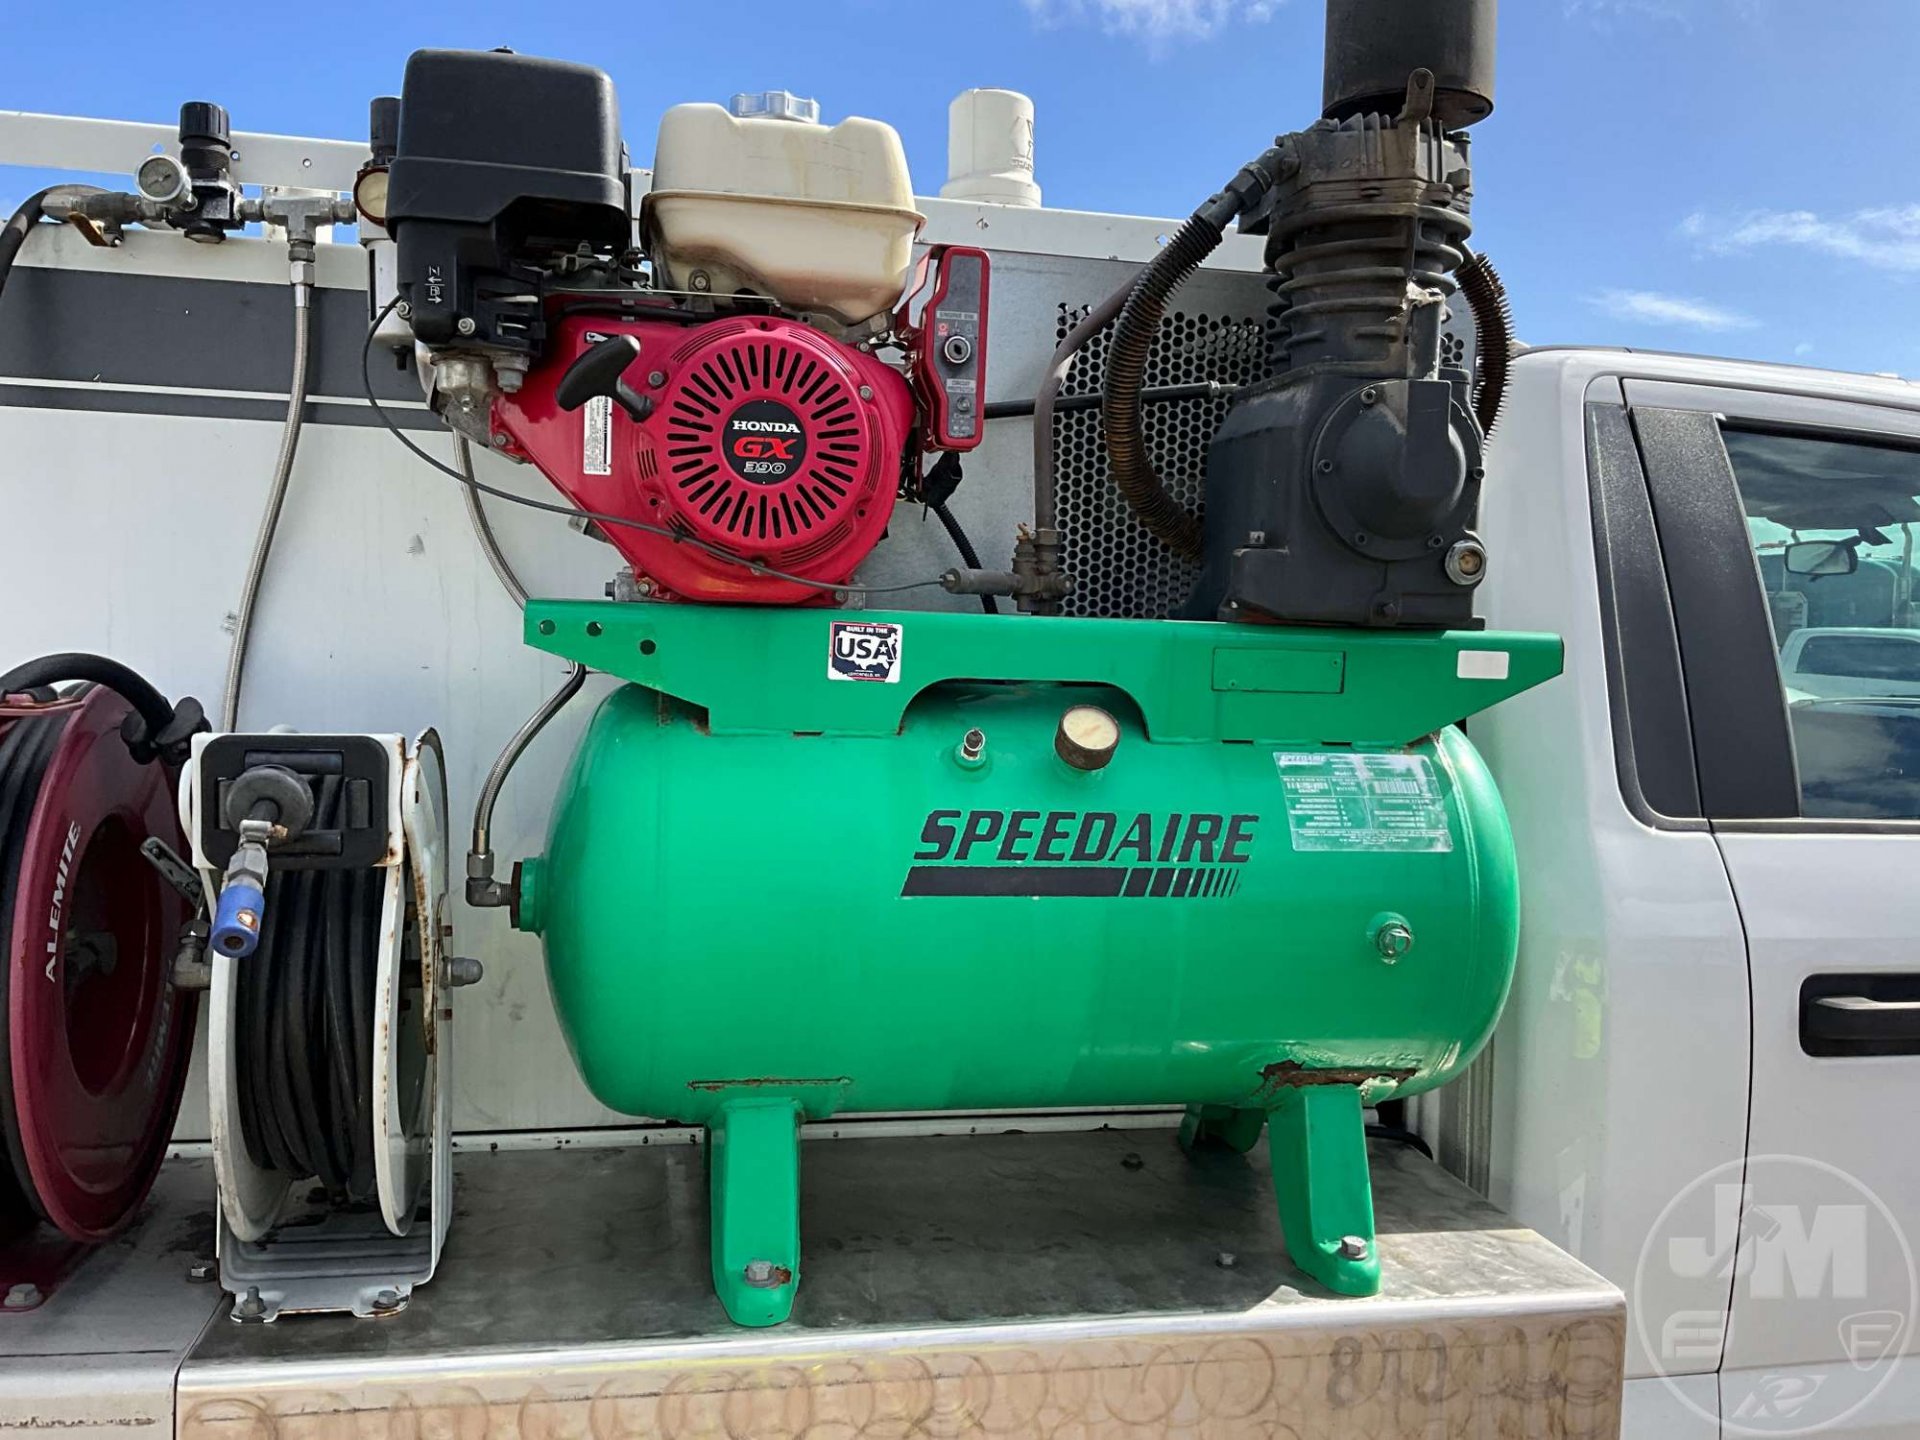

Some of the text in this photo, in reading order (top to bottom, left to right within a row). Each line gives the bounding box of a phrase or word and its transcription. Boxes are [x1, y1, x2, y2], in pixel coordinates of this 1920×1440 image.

[732, 420, 801, 433] HONDA
[733, 436, 797, 459] GX
[743, 461, 786, 475] 390
[836, 637, 893, 660] USA
[914, 810, 1260, 863] SPEEDAIRE
[45, 820, 81, 983] ALEMITE
